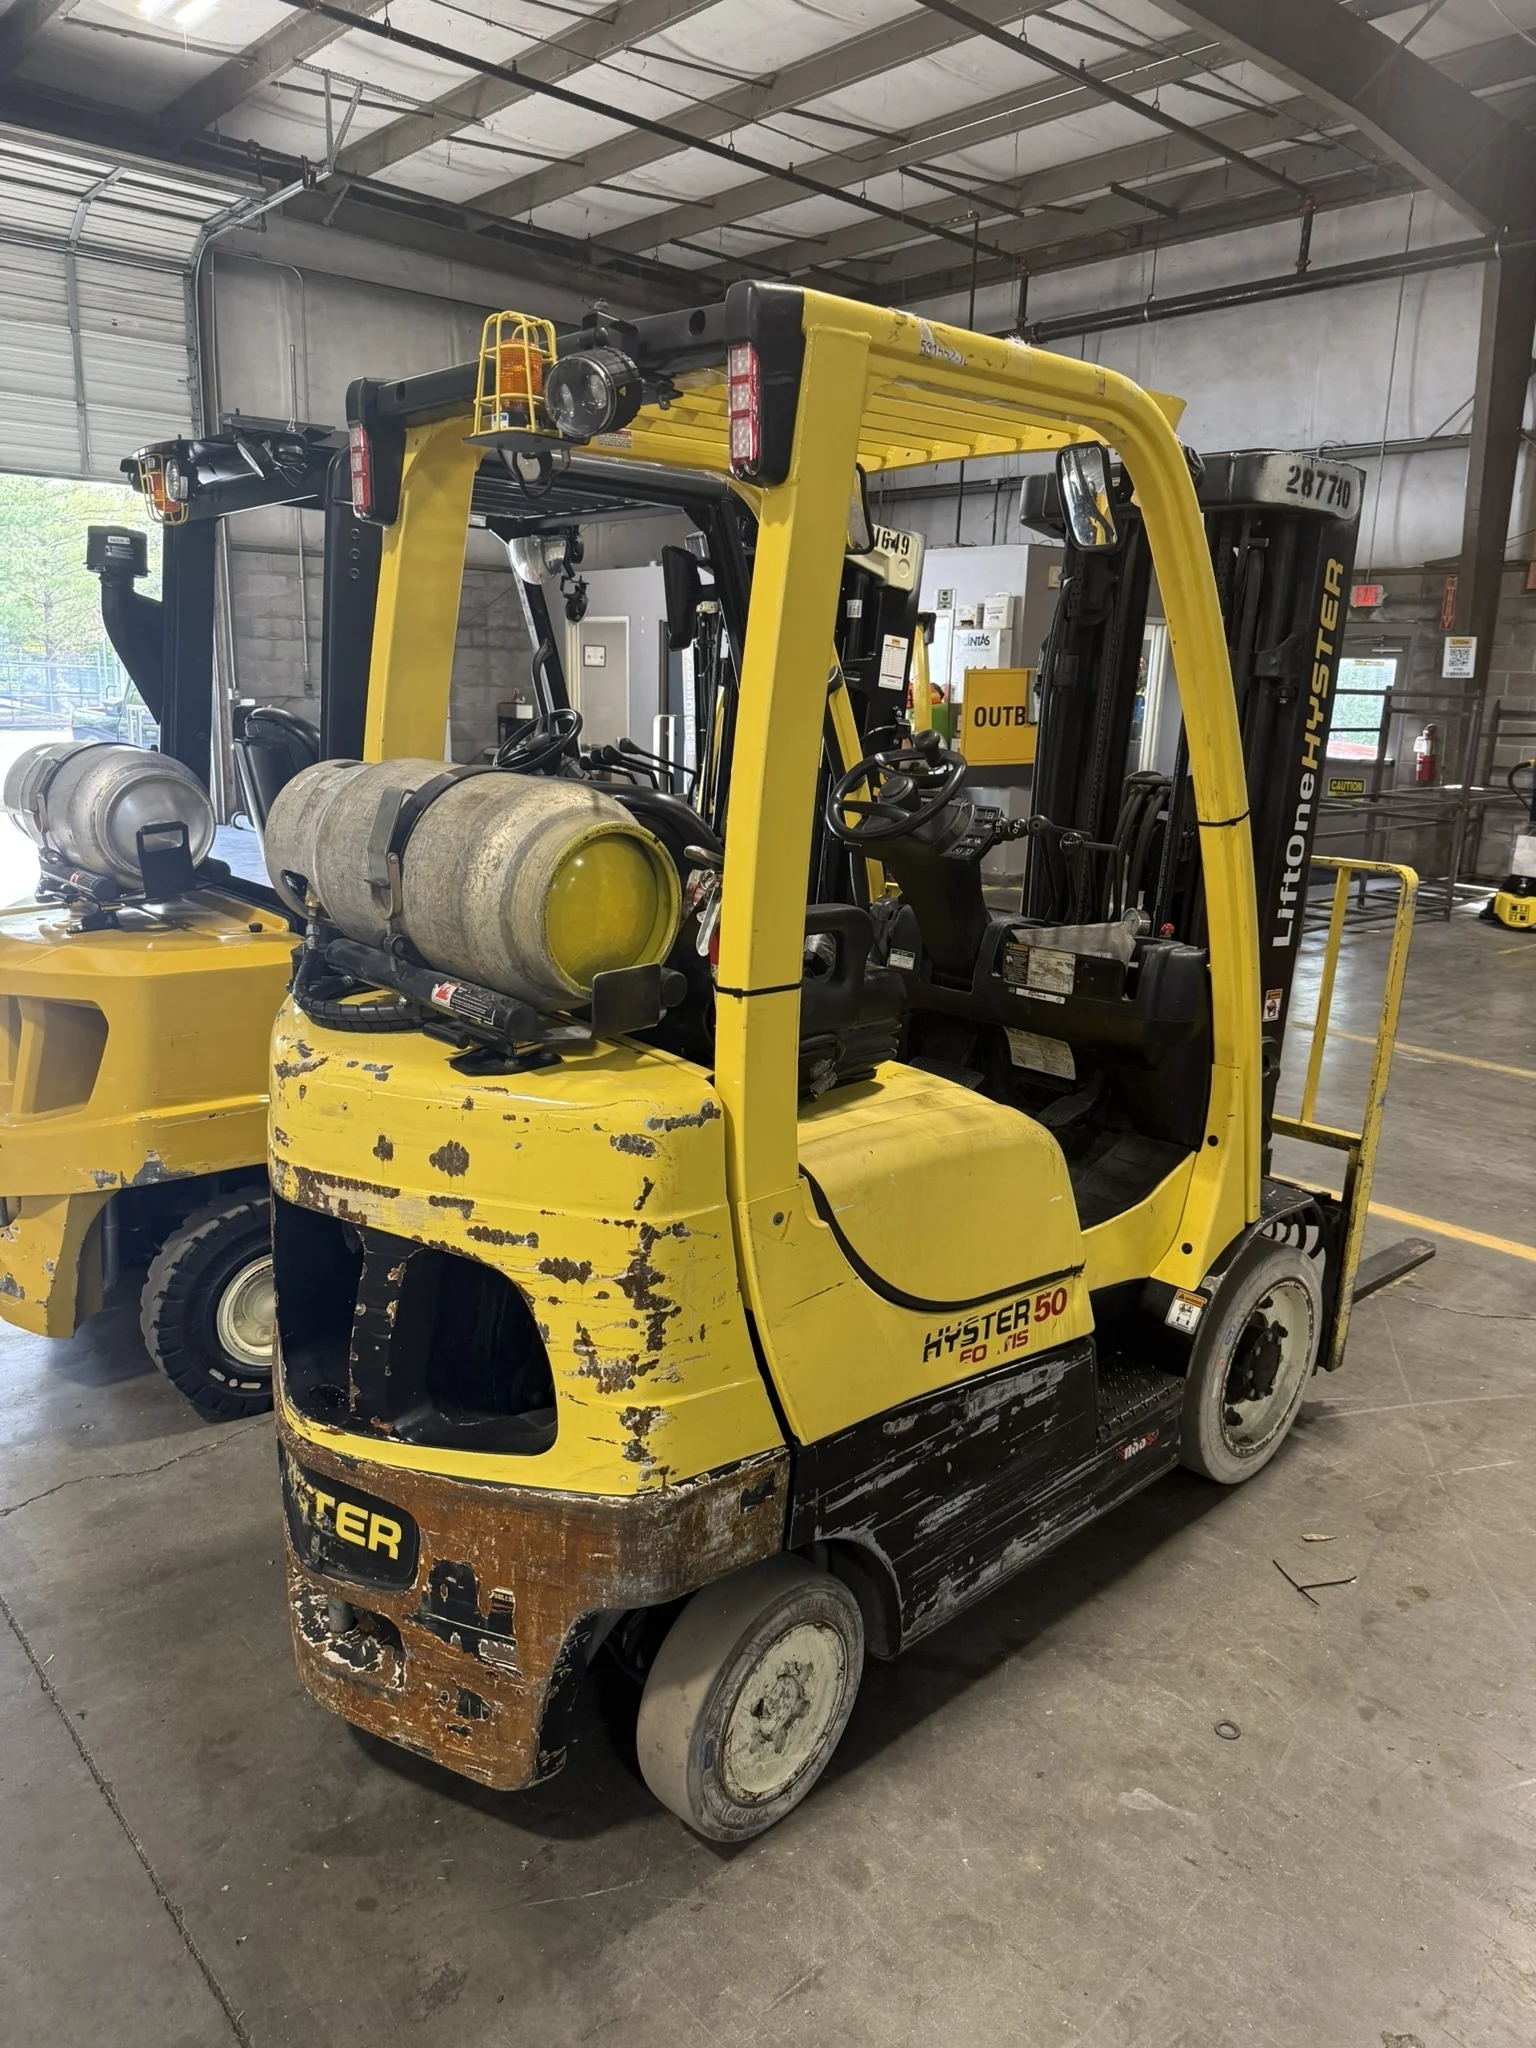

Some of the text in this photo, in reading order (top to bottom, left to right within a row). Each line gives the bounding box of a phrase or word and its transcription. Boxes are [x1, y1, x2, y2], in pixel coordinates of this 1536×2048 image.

[1301, 558, 1344, 770] HYSTER
[1331, 780, 1363, 792] CAUTION
[1272, 772, 1315, 947] LiftOne
[923, 1287, 1067, 1363] HYSTER 50
